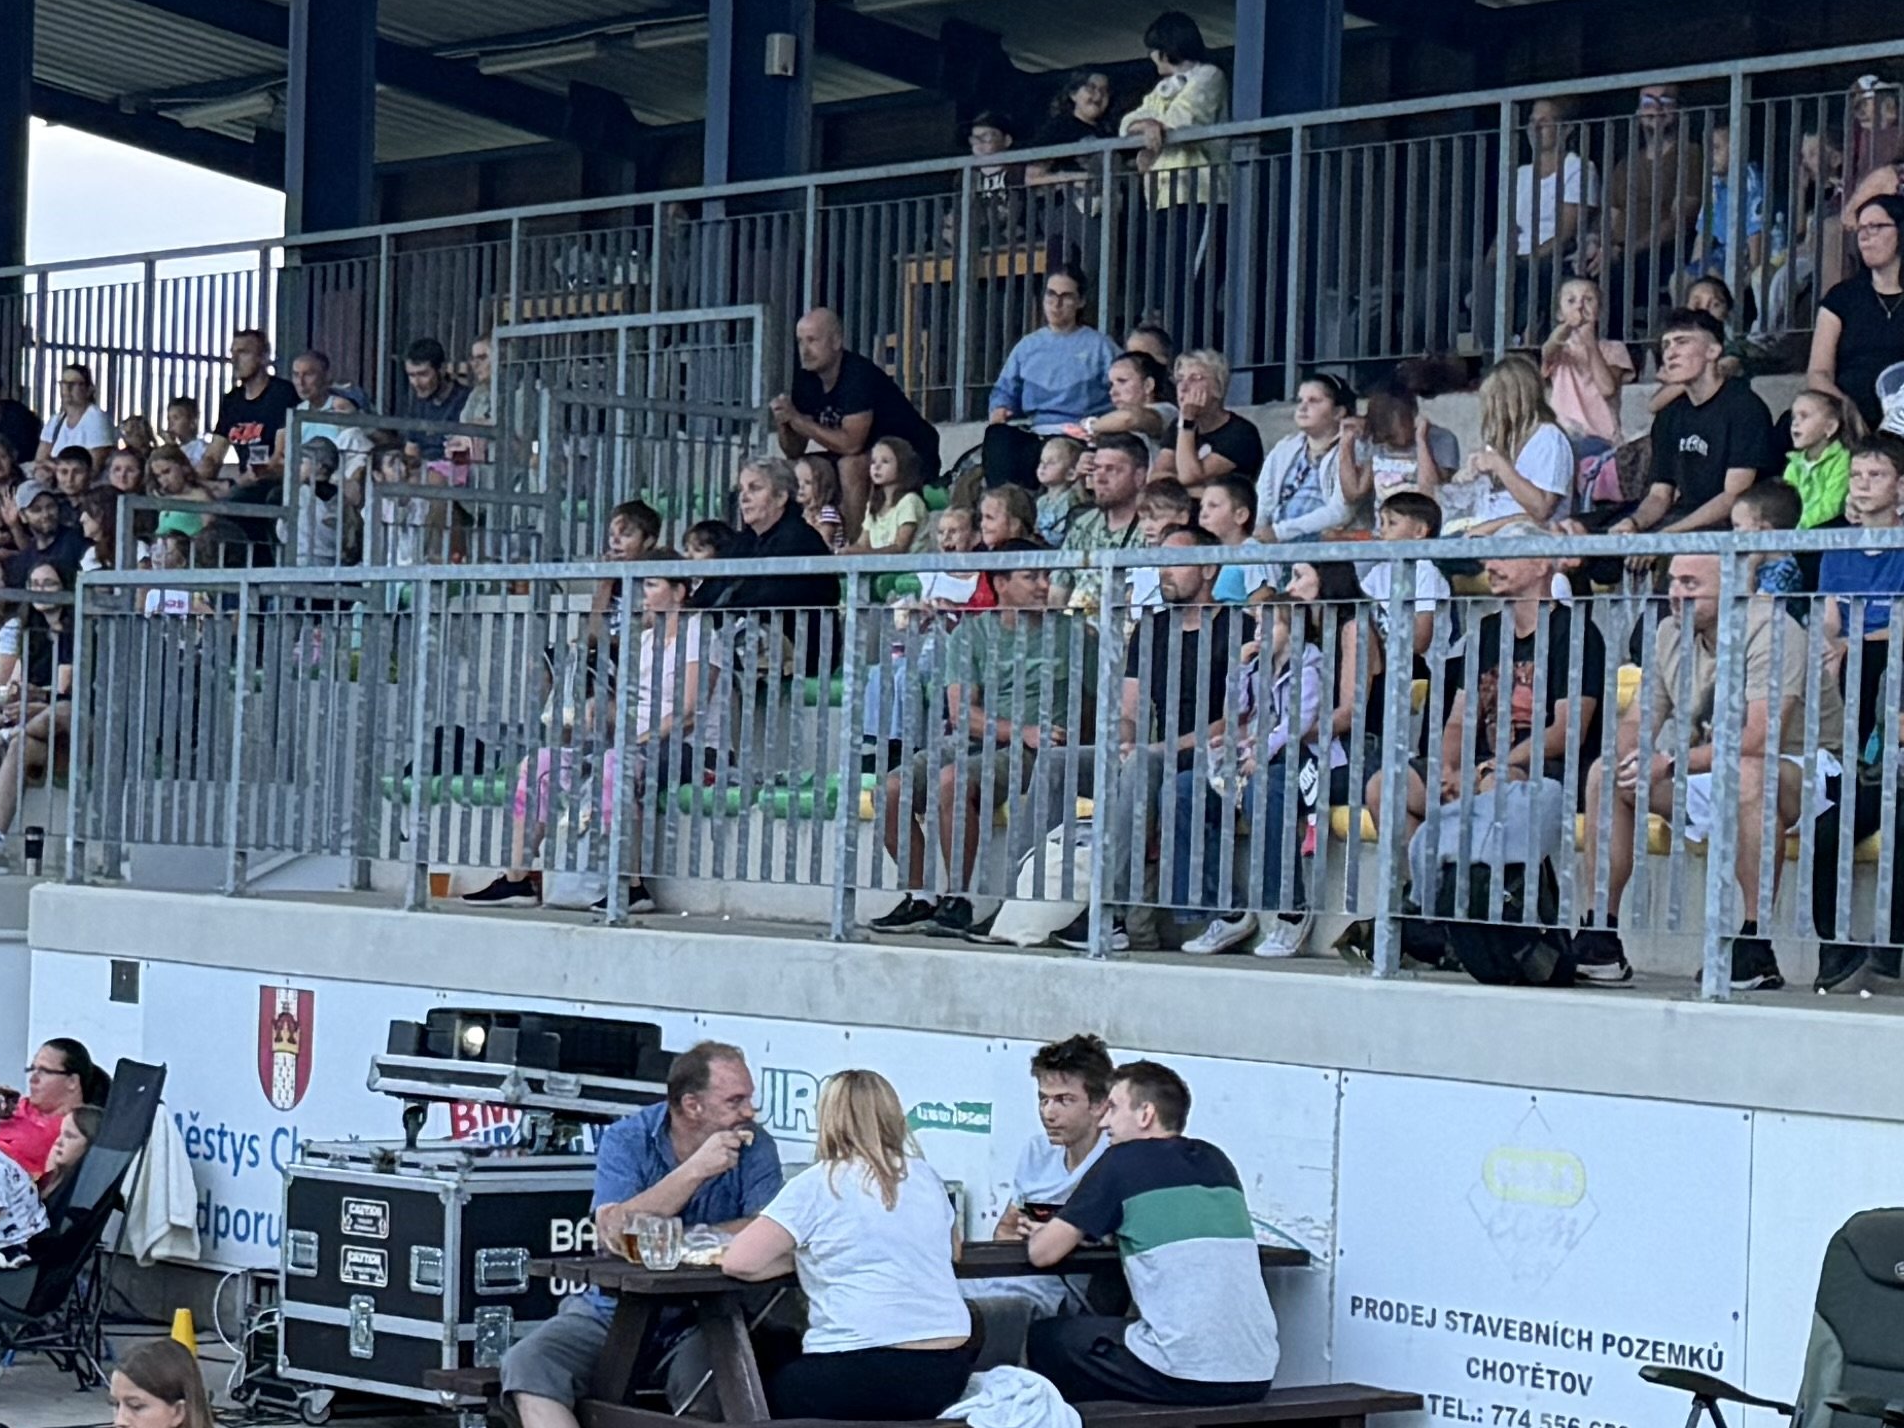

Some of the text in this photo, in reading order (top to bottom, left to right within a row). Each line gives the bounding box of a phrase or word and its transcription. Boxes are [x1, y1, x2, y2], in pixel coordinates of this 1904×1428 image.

[1350, 1295, 1725, 1373] PRODEJ STAVEBNÍCH POZEMKŮ
[1466, 1356, 1593, 1398] CHOTĚTOV
[1428, 1394, 1484, 1424] TEL.:
